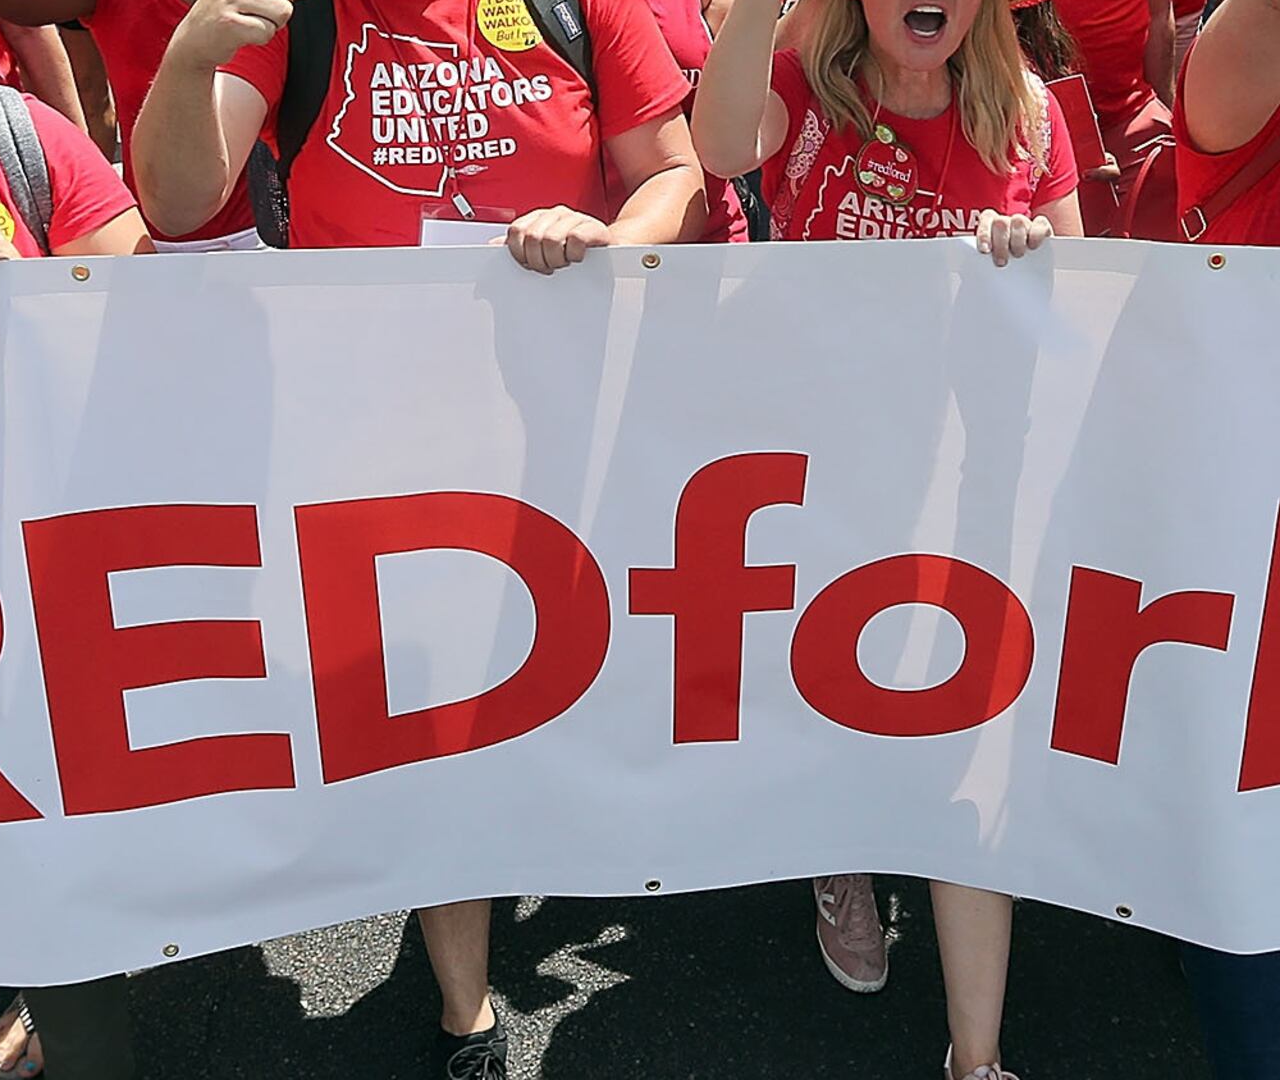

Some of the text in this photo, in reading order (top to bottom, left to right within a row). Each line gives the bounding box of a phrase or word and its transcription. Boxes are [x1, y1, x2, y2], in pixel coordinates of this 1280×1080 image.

[482, 4, 521, 18] WANT
[484, 16, 531, 30] WALKO
[371, 56, 505, 90] ARIZONA
[371, 74, 553, 116] EDUCATORS
[372, 112, 489, 144] UNITED
[373, 137, 517, 166] #REDFORED
